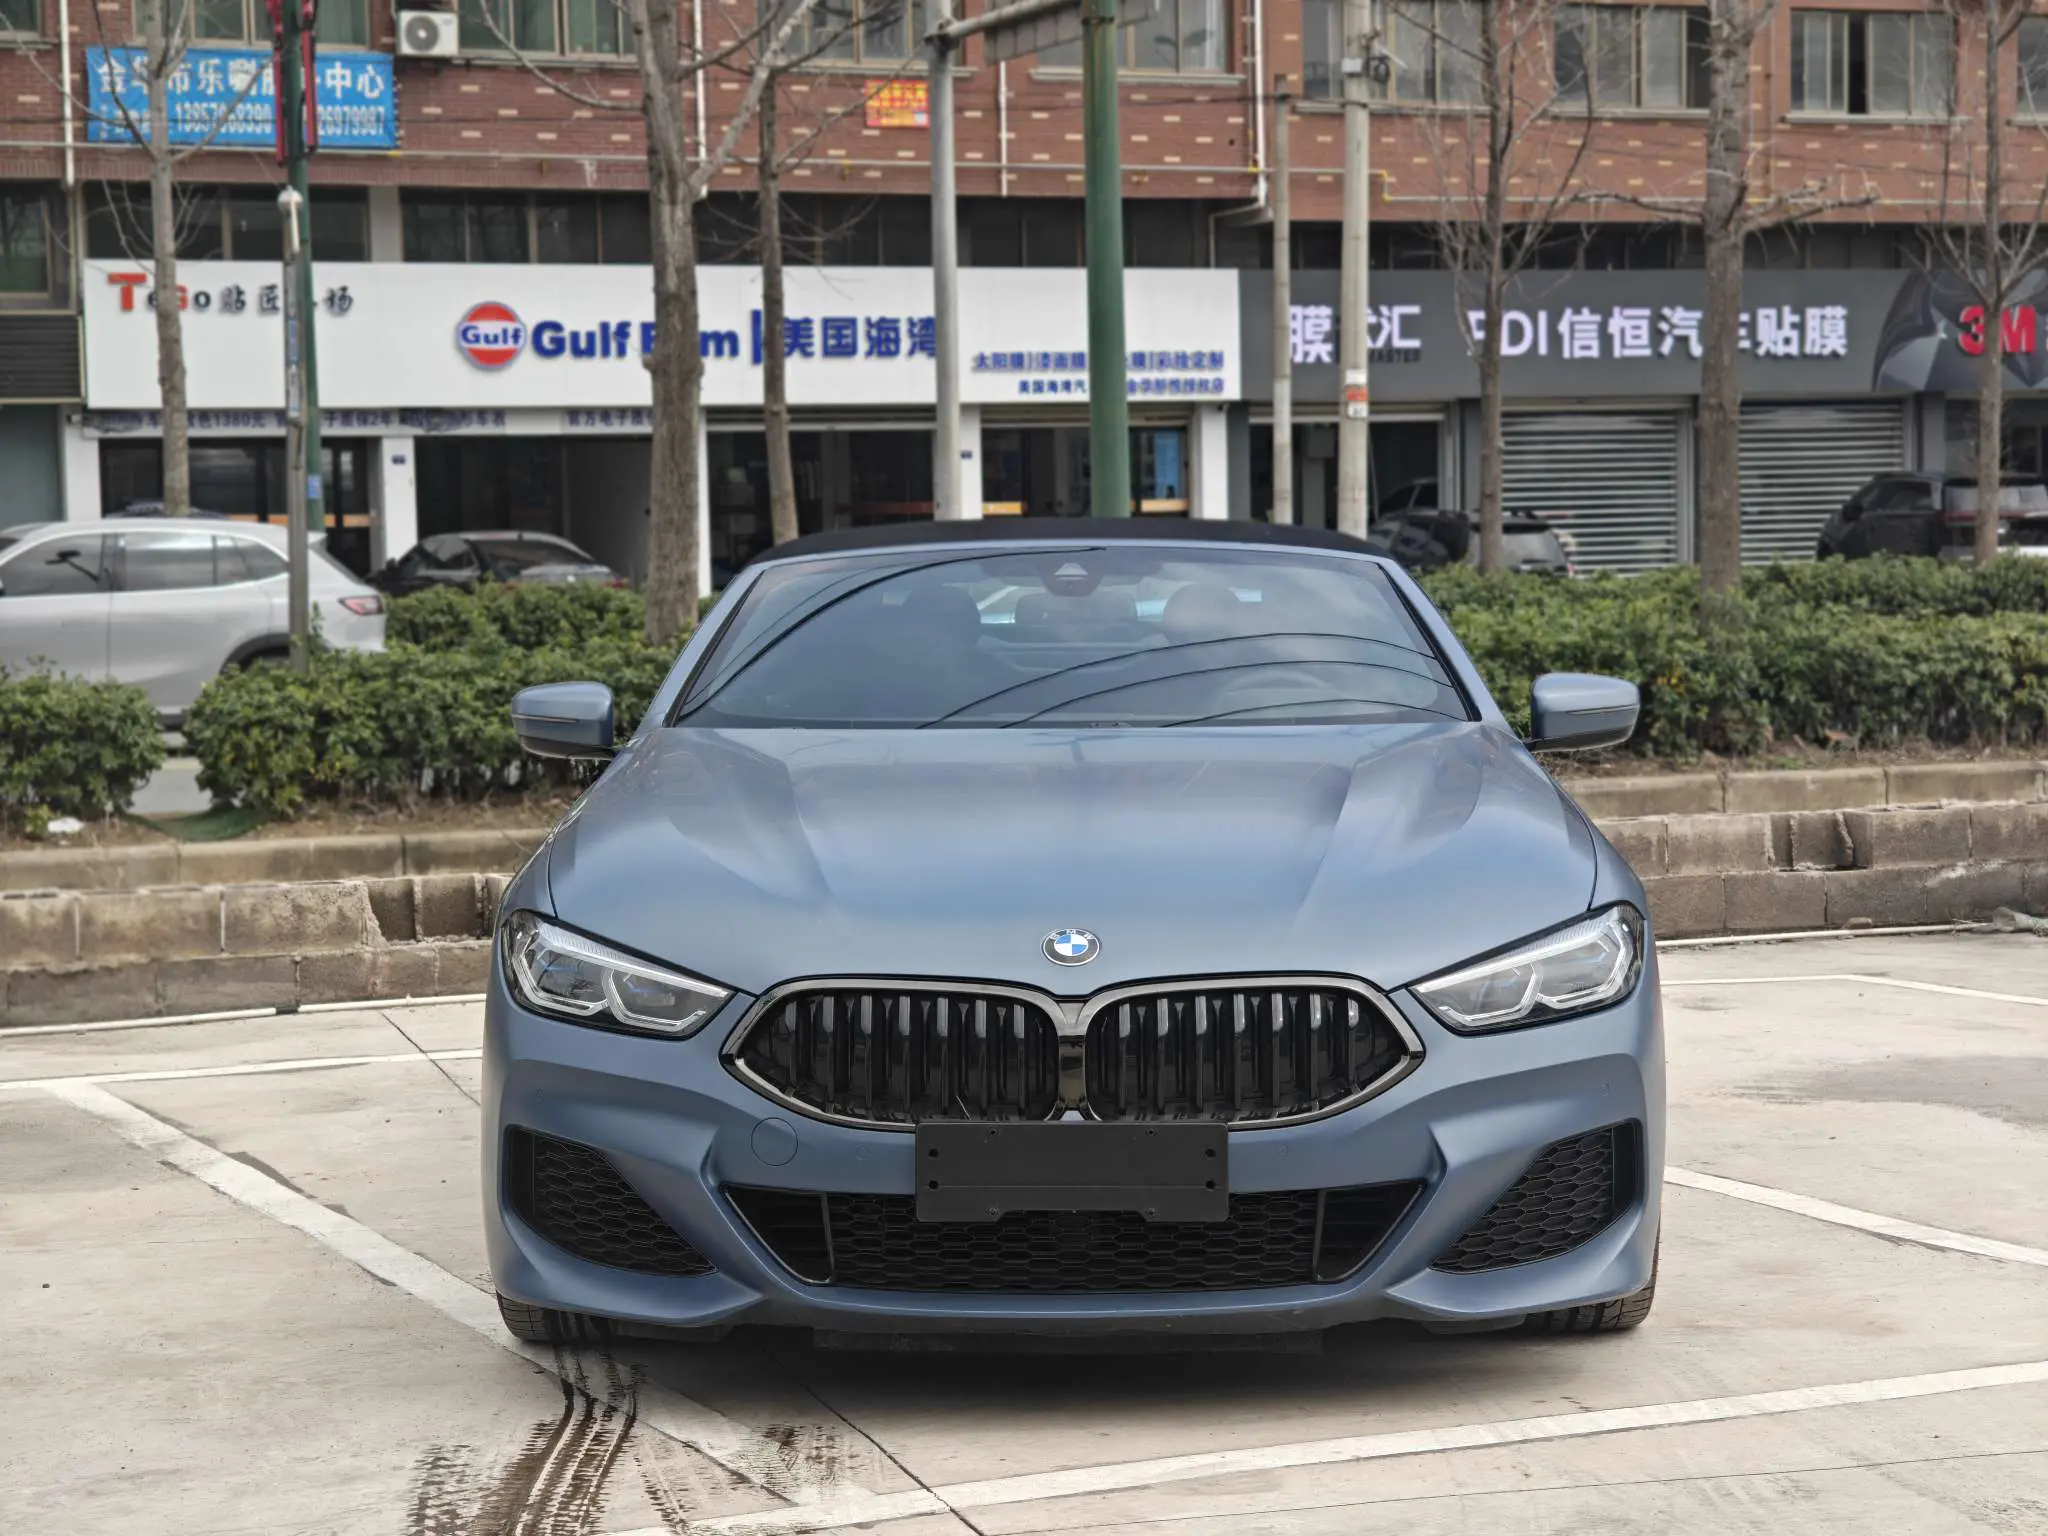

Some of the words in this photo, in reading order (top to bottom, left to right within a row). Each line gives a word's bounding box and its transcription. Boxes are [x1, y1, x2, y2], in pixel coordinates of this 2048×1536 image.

[219, 284, 354, 316] 贴匠场
[461, 325, 522, 345] Gulf
[531, 320, 631, 359] Gulf
[639, 321, 740, 358] Fm
[782, 317, 937, 358] 美国海湾
[1958, 304, 2037, 355] 3M
